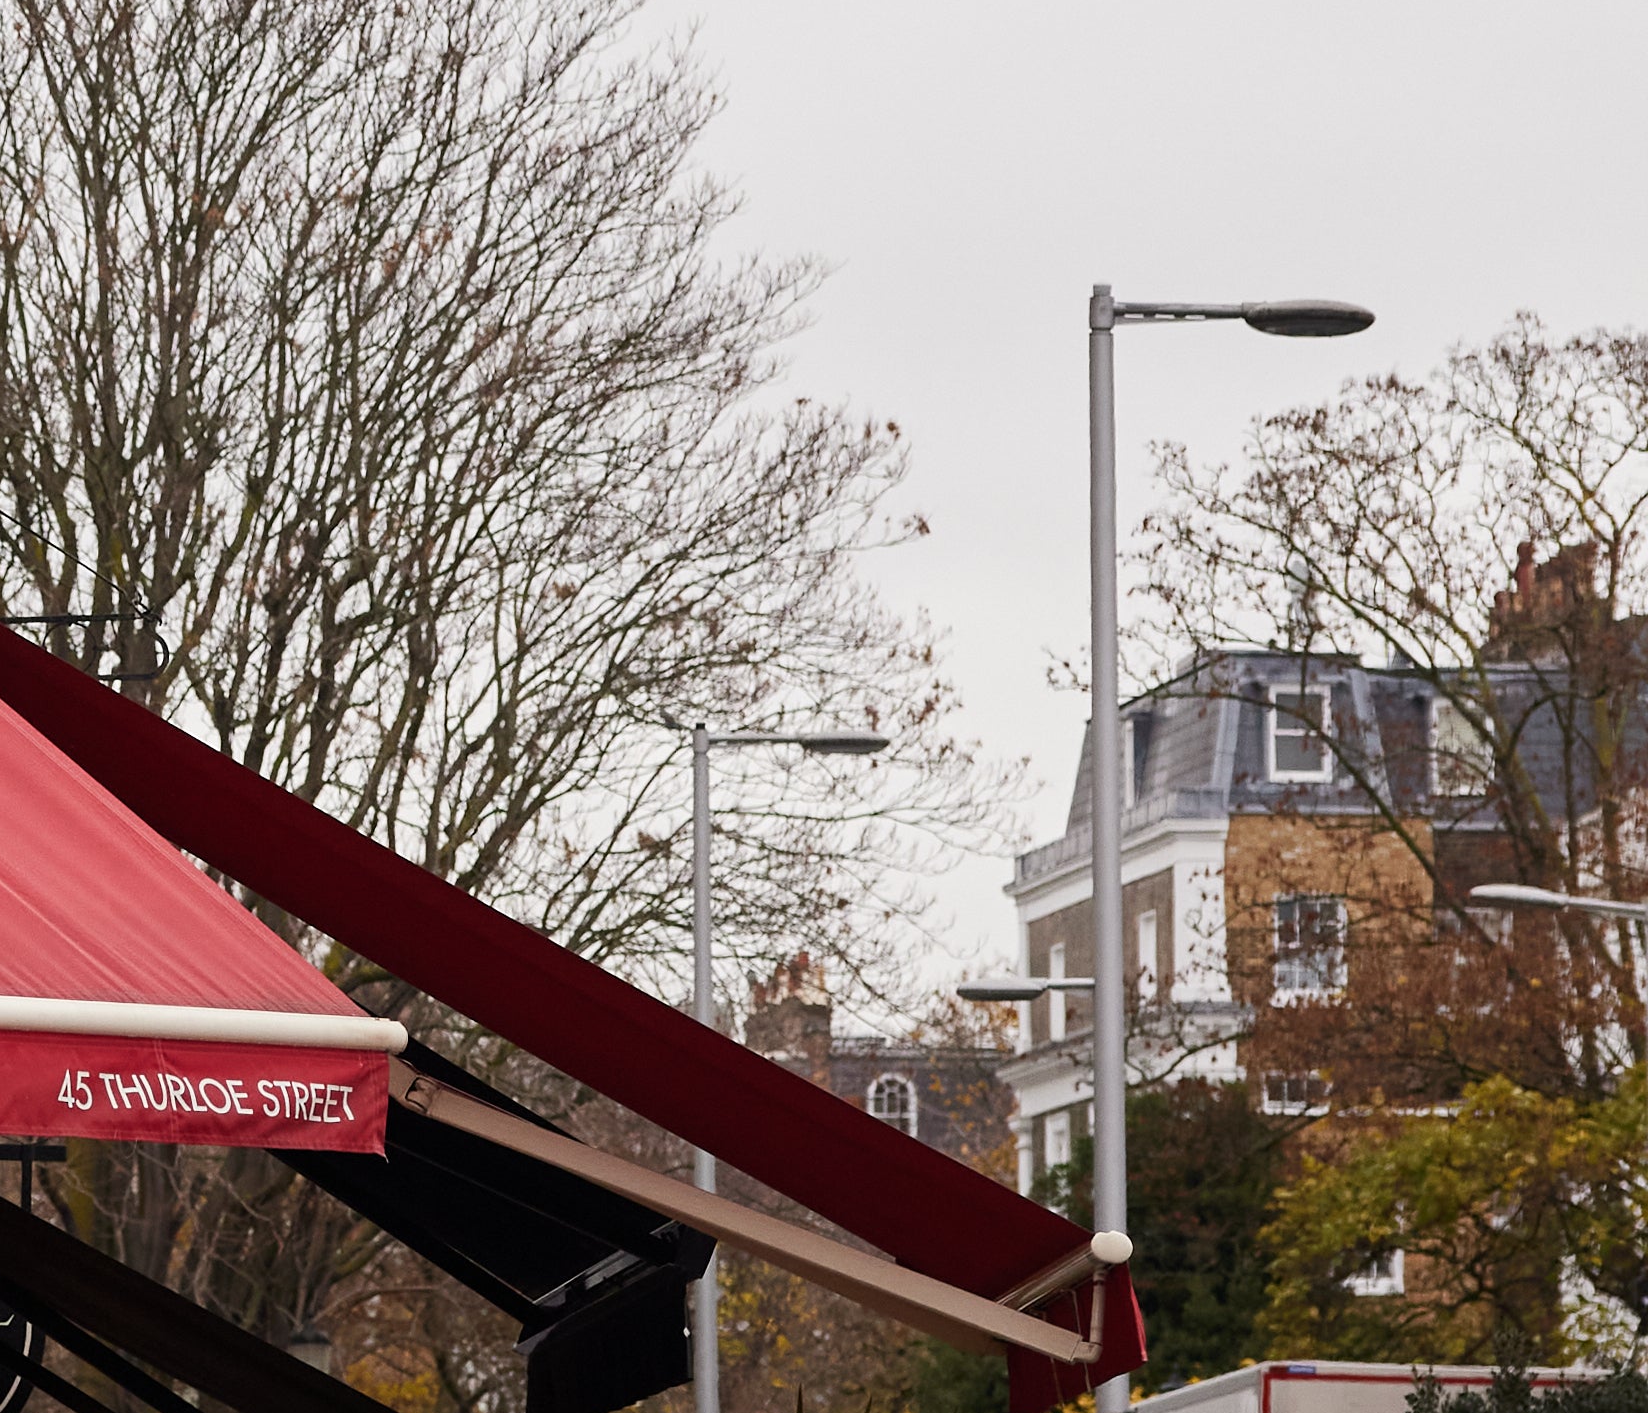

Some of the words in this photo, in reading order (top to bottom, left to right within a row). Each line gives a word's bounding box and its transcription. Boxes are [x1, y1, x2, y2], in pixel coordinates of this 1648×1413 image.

[57, 1069, 94, 1110] 45
[97, 1073, 254, 1116] THURLOE
[261, 1081, 356, 1124] STREET
